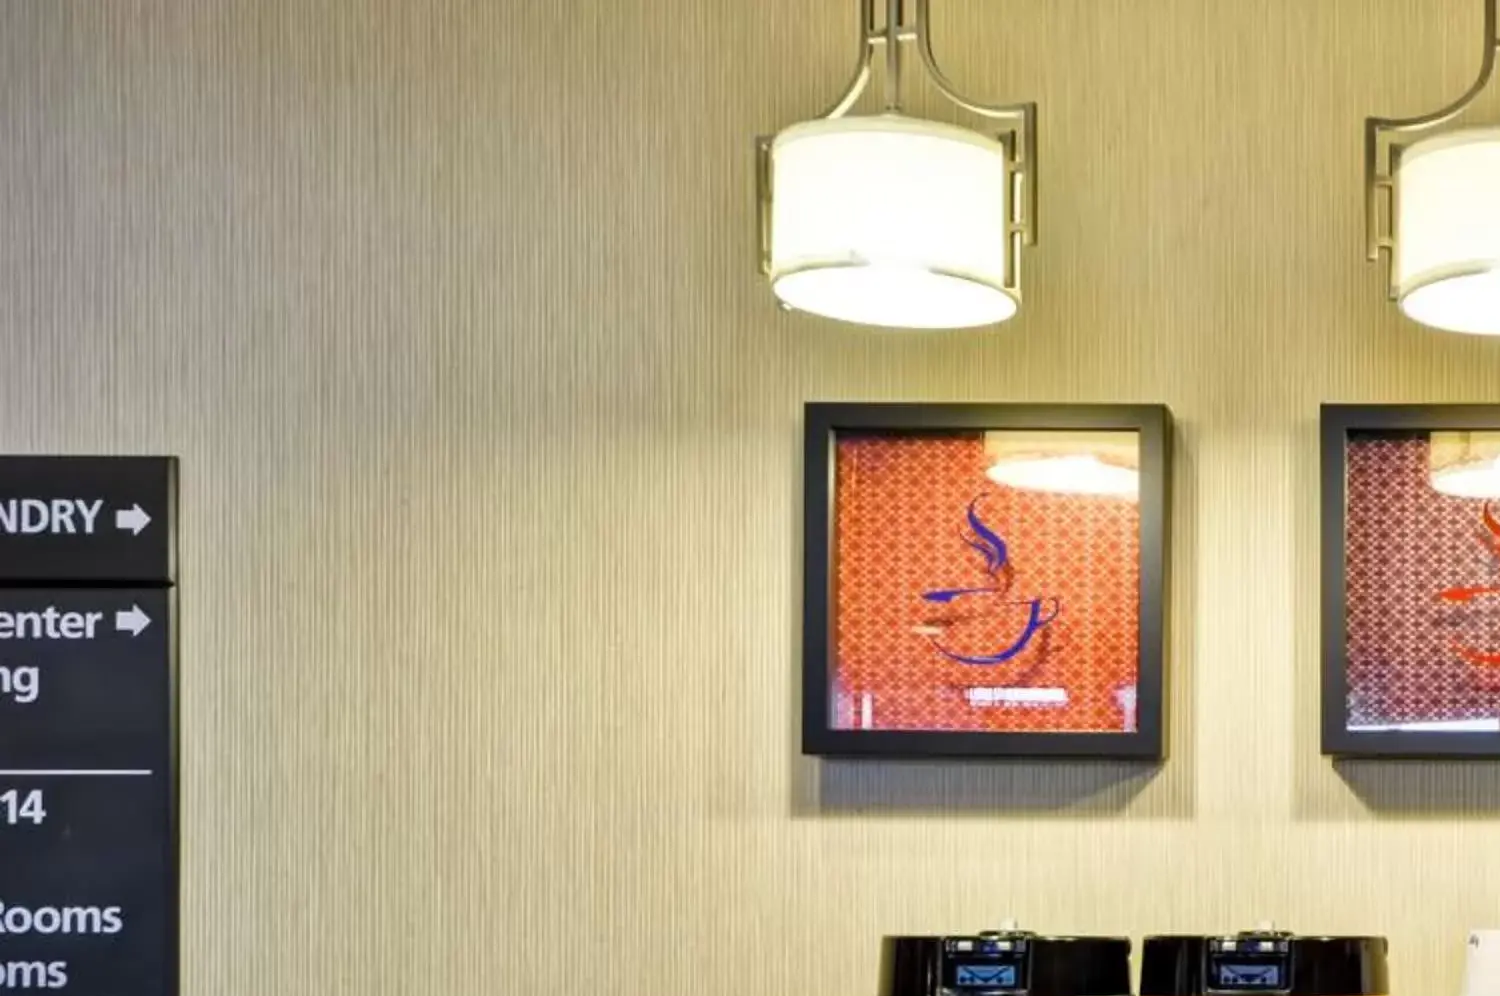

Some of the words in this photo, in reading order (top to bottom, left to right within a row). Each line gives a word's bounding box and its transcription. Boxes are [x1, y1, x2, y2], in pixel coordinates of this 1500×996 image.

[0, 499, 103, 534] NDRY
[0, 606, 102, 639] enter
[0, 789, 46, 825] 14
[0, 901, 123, 935] ooms
[0, 960, 68, 989] ms
